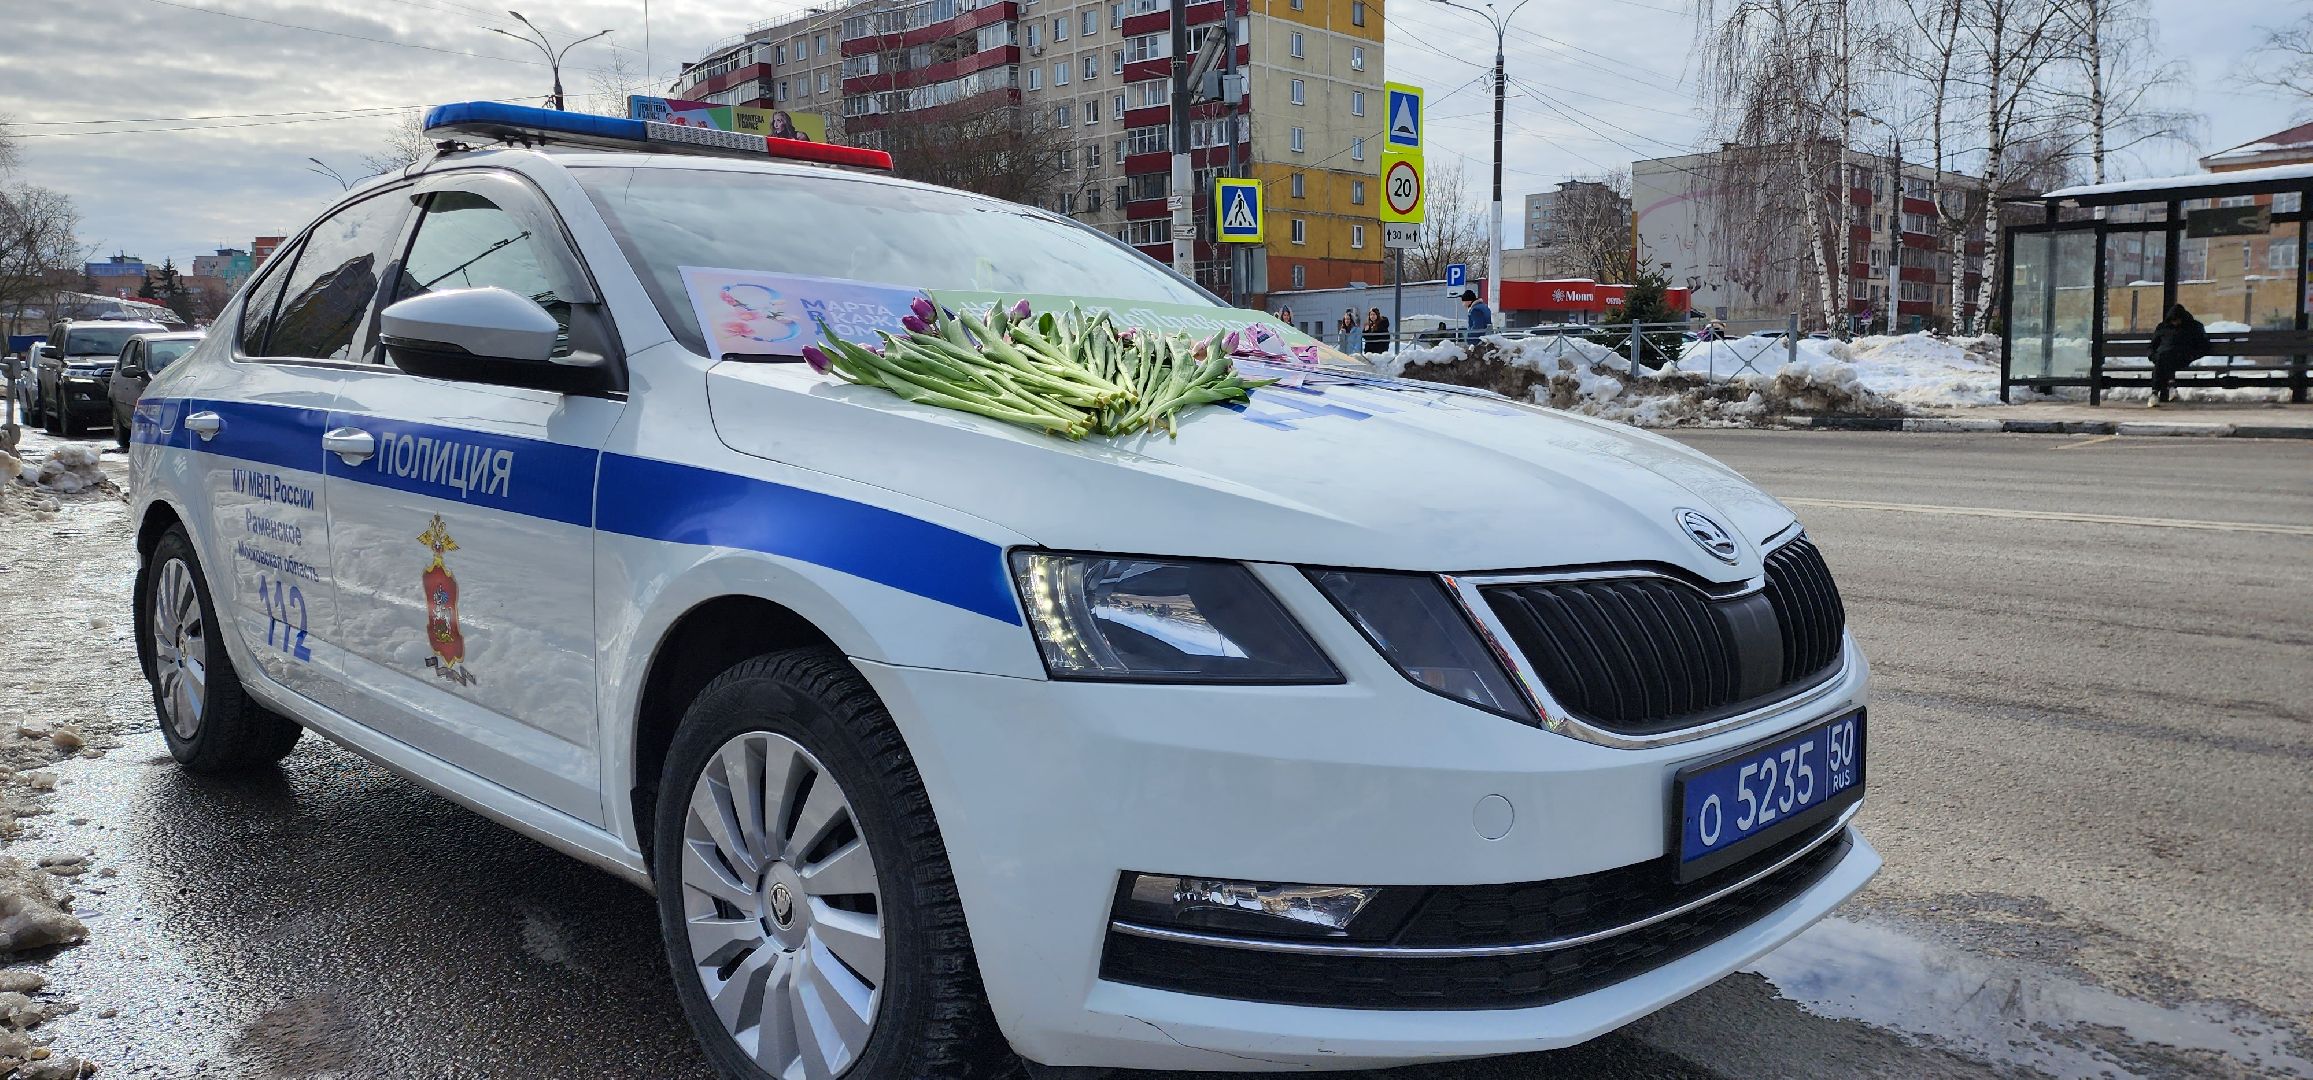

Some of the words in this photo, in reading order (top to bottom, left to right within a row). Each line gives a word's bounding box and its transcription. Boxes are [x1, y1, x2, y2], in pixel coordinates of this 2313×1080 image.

[1394, 177, 1412, 197] 20
[1392, 231, 1402, 240] 30
[800, 298, 896, 317] МАРТА
[806, 310, 826, 321] В
[829, 312, 904, 328] КАЖ
[378, 431, 514, 498] ПОЛИЦИЯ
[232, 468, 246, 494] МУ
[248, 471, 271, 505] МВД
[274, 476, 314, 511] России
[245, 507, 302, 546] Раменское
[236, 540, 282, 571] Московская
[284, 556, 320, 583] область
[259, 575, 312, 663] 112
[1737, 740, 1815, 831] 5235
[1829, 720, 1854, 771] 50
[1833, 769, 1852, 793] RUS
